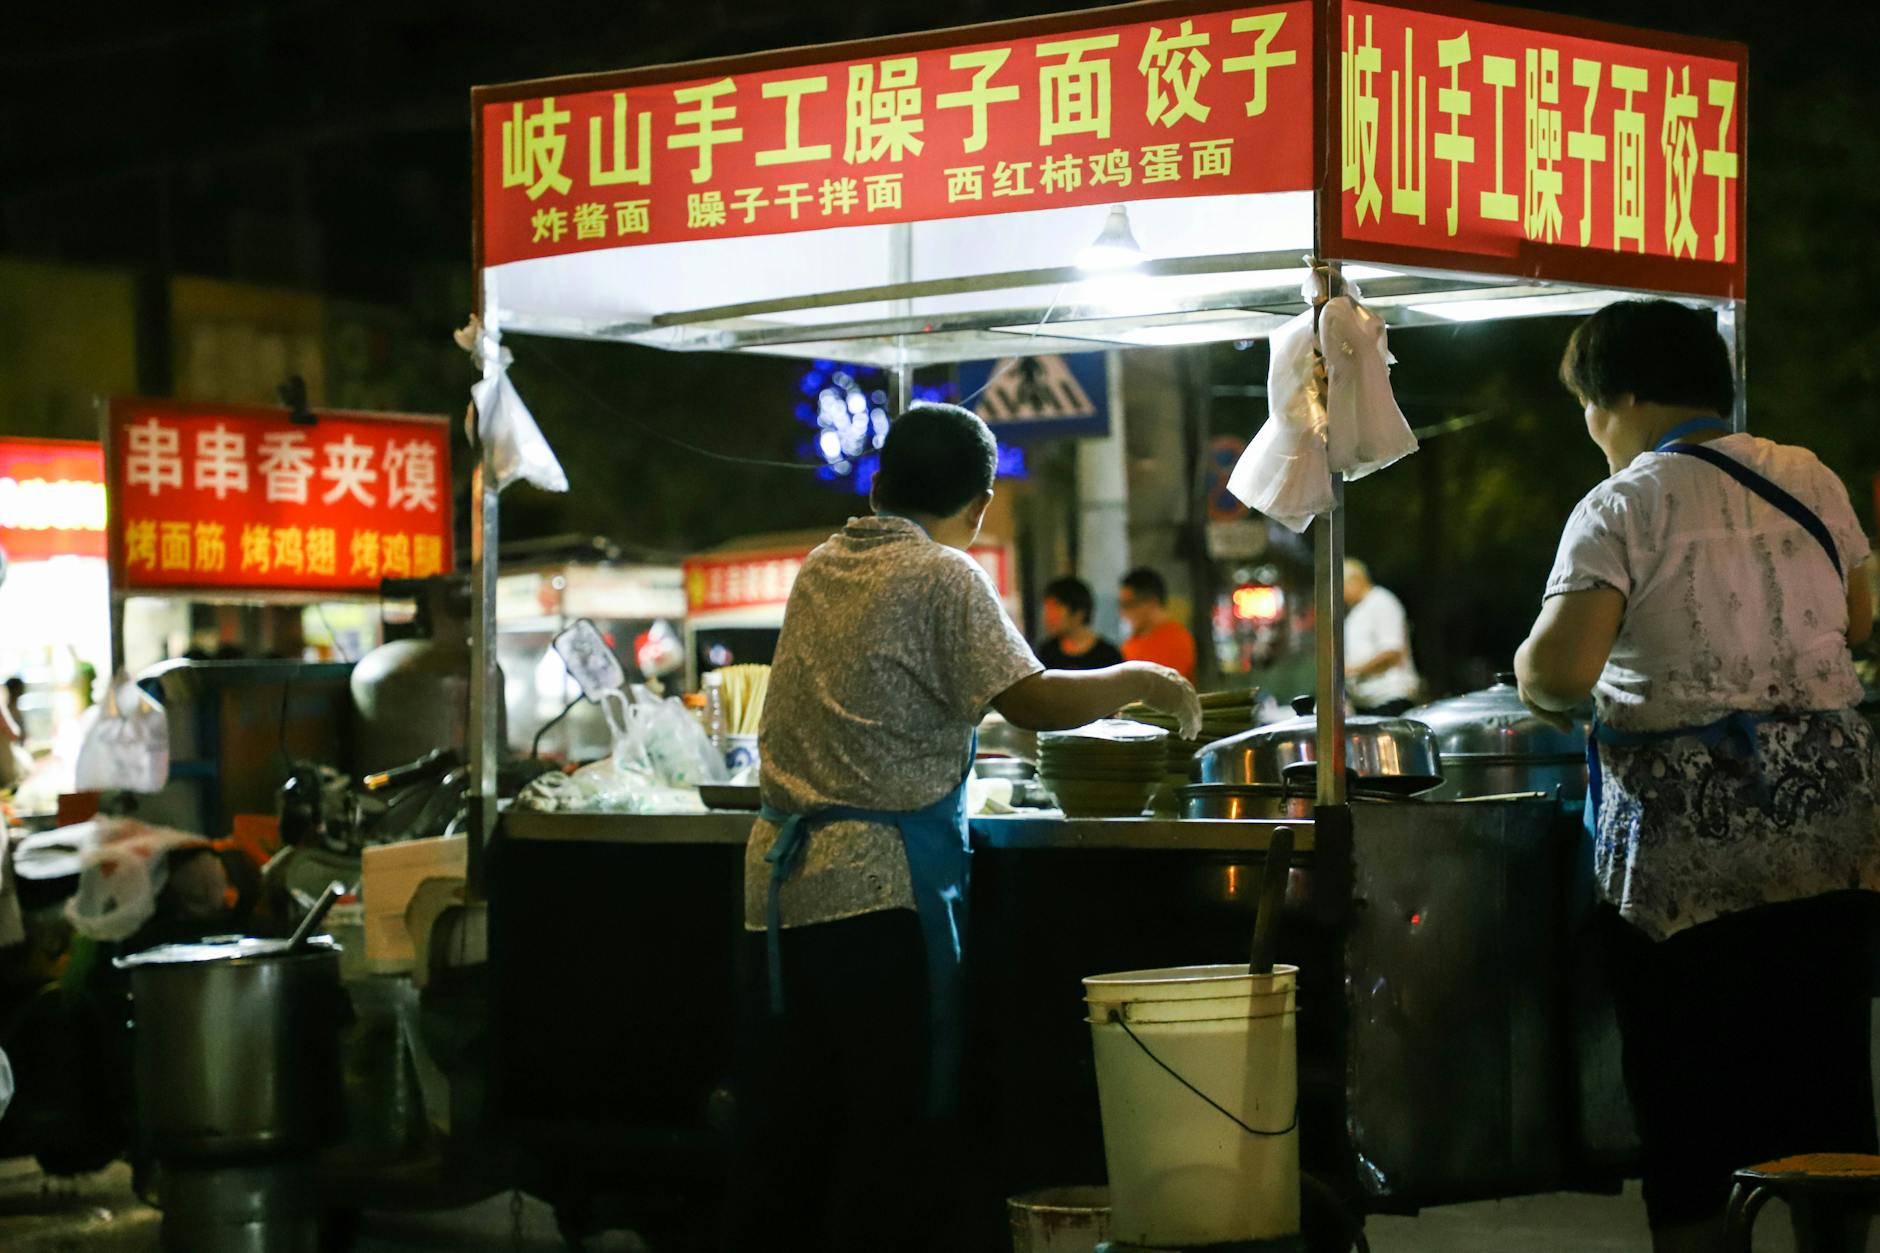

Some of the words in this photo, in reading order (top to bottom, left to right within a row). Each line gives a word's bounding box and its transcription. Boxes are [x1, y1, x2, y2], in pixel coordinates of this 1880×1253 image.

[503, 12, 1297, 200] 岐山手工臊子面饺子
[1342, 15, 1738, 262] 岐山手工臊子面饺子
[532, 199, 651, 243] 炸酱面
[687, 173, 904, 229] 臊子干拌面
[944, 138, 1235, 203] 西红柿鸡蛋面
[126, 418, 438, 513] 串串香夹馍
[125, 519, 226, 571] 烤面筋
[240, 523, 337, 576] 烤鸡翅
